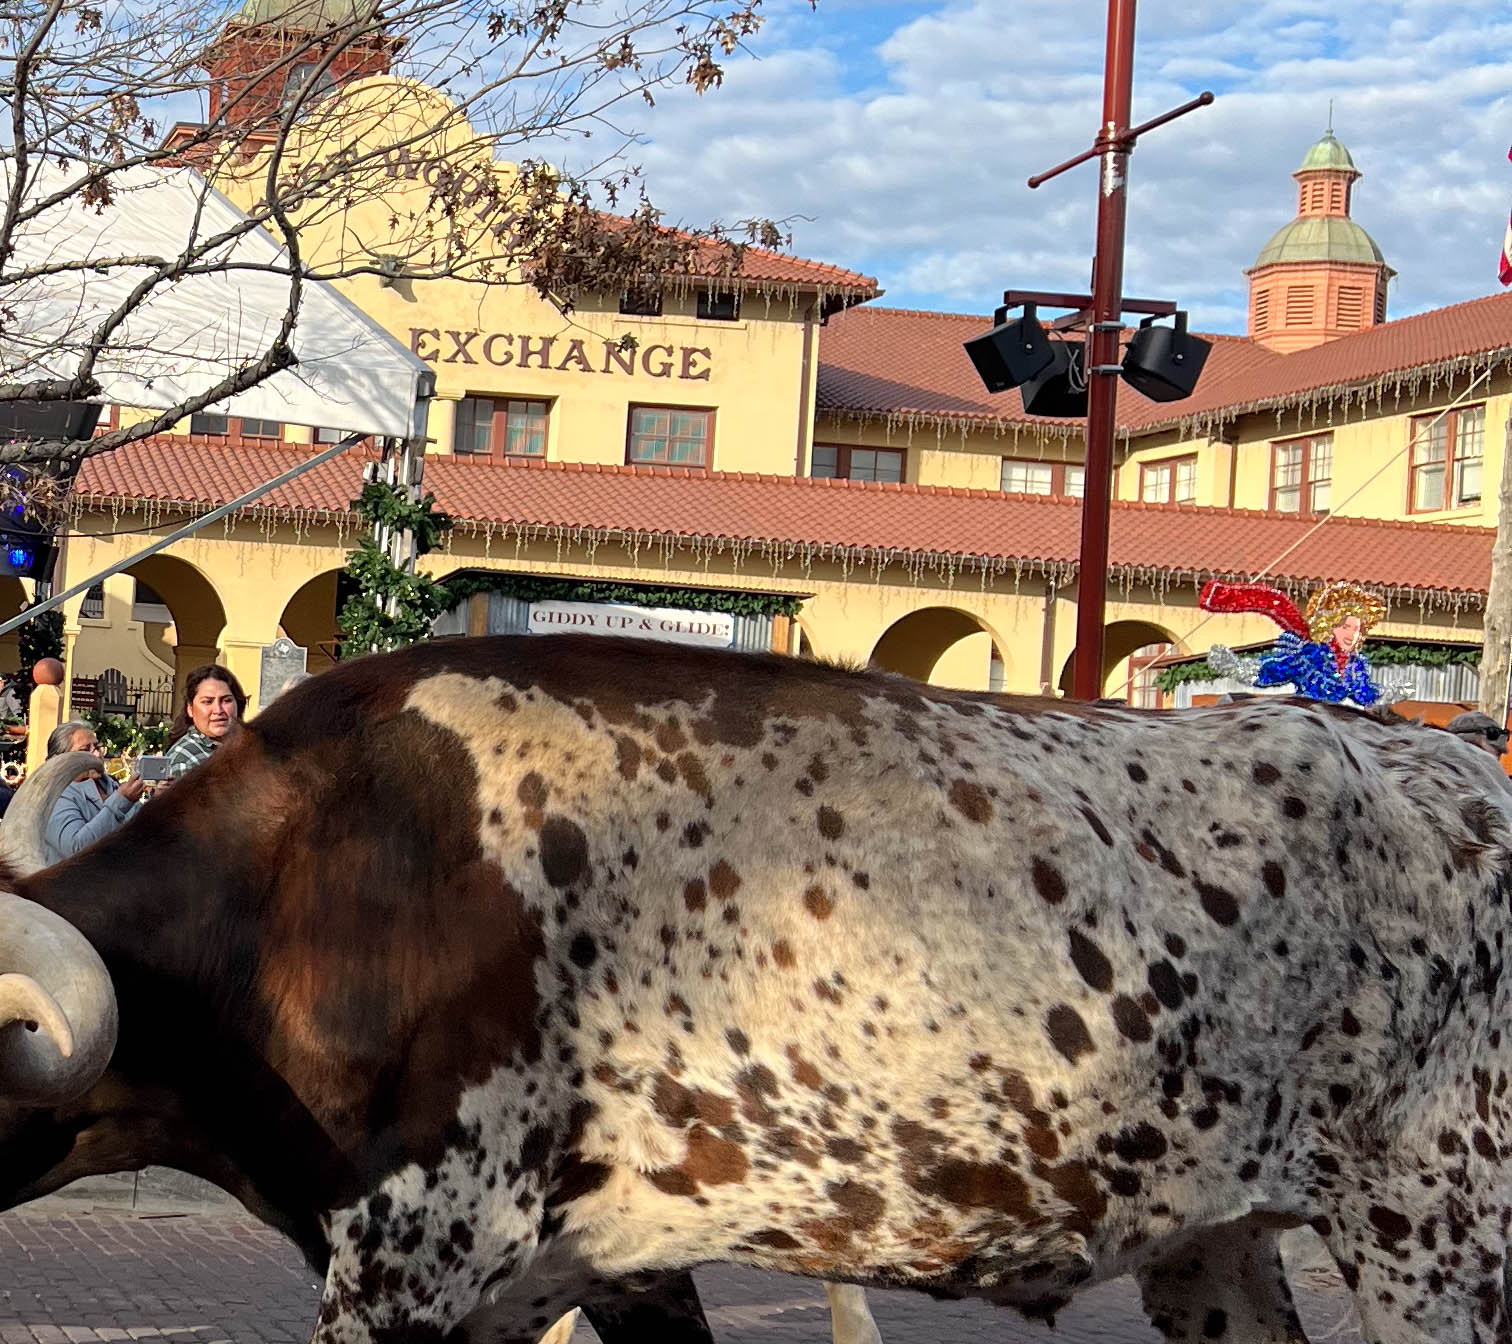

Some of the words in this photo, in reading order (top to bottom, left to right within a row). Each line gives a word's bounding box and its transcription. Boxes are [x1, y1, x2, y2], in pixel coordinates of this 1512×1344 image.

[408, 327, 713, 382] EXCHANGE
[532, 609, 599, 627] GIDDY
[605, 615, 634, 630] UP
[638, 618, 653, 631] &
[659, 619, 731, 637] GLIDE!
